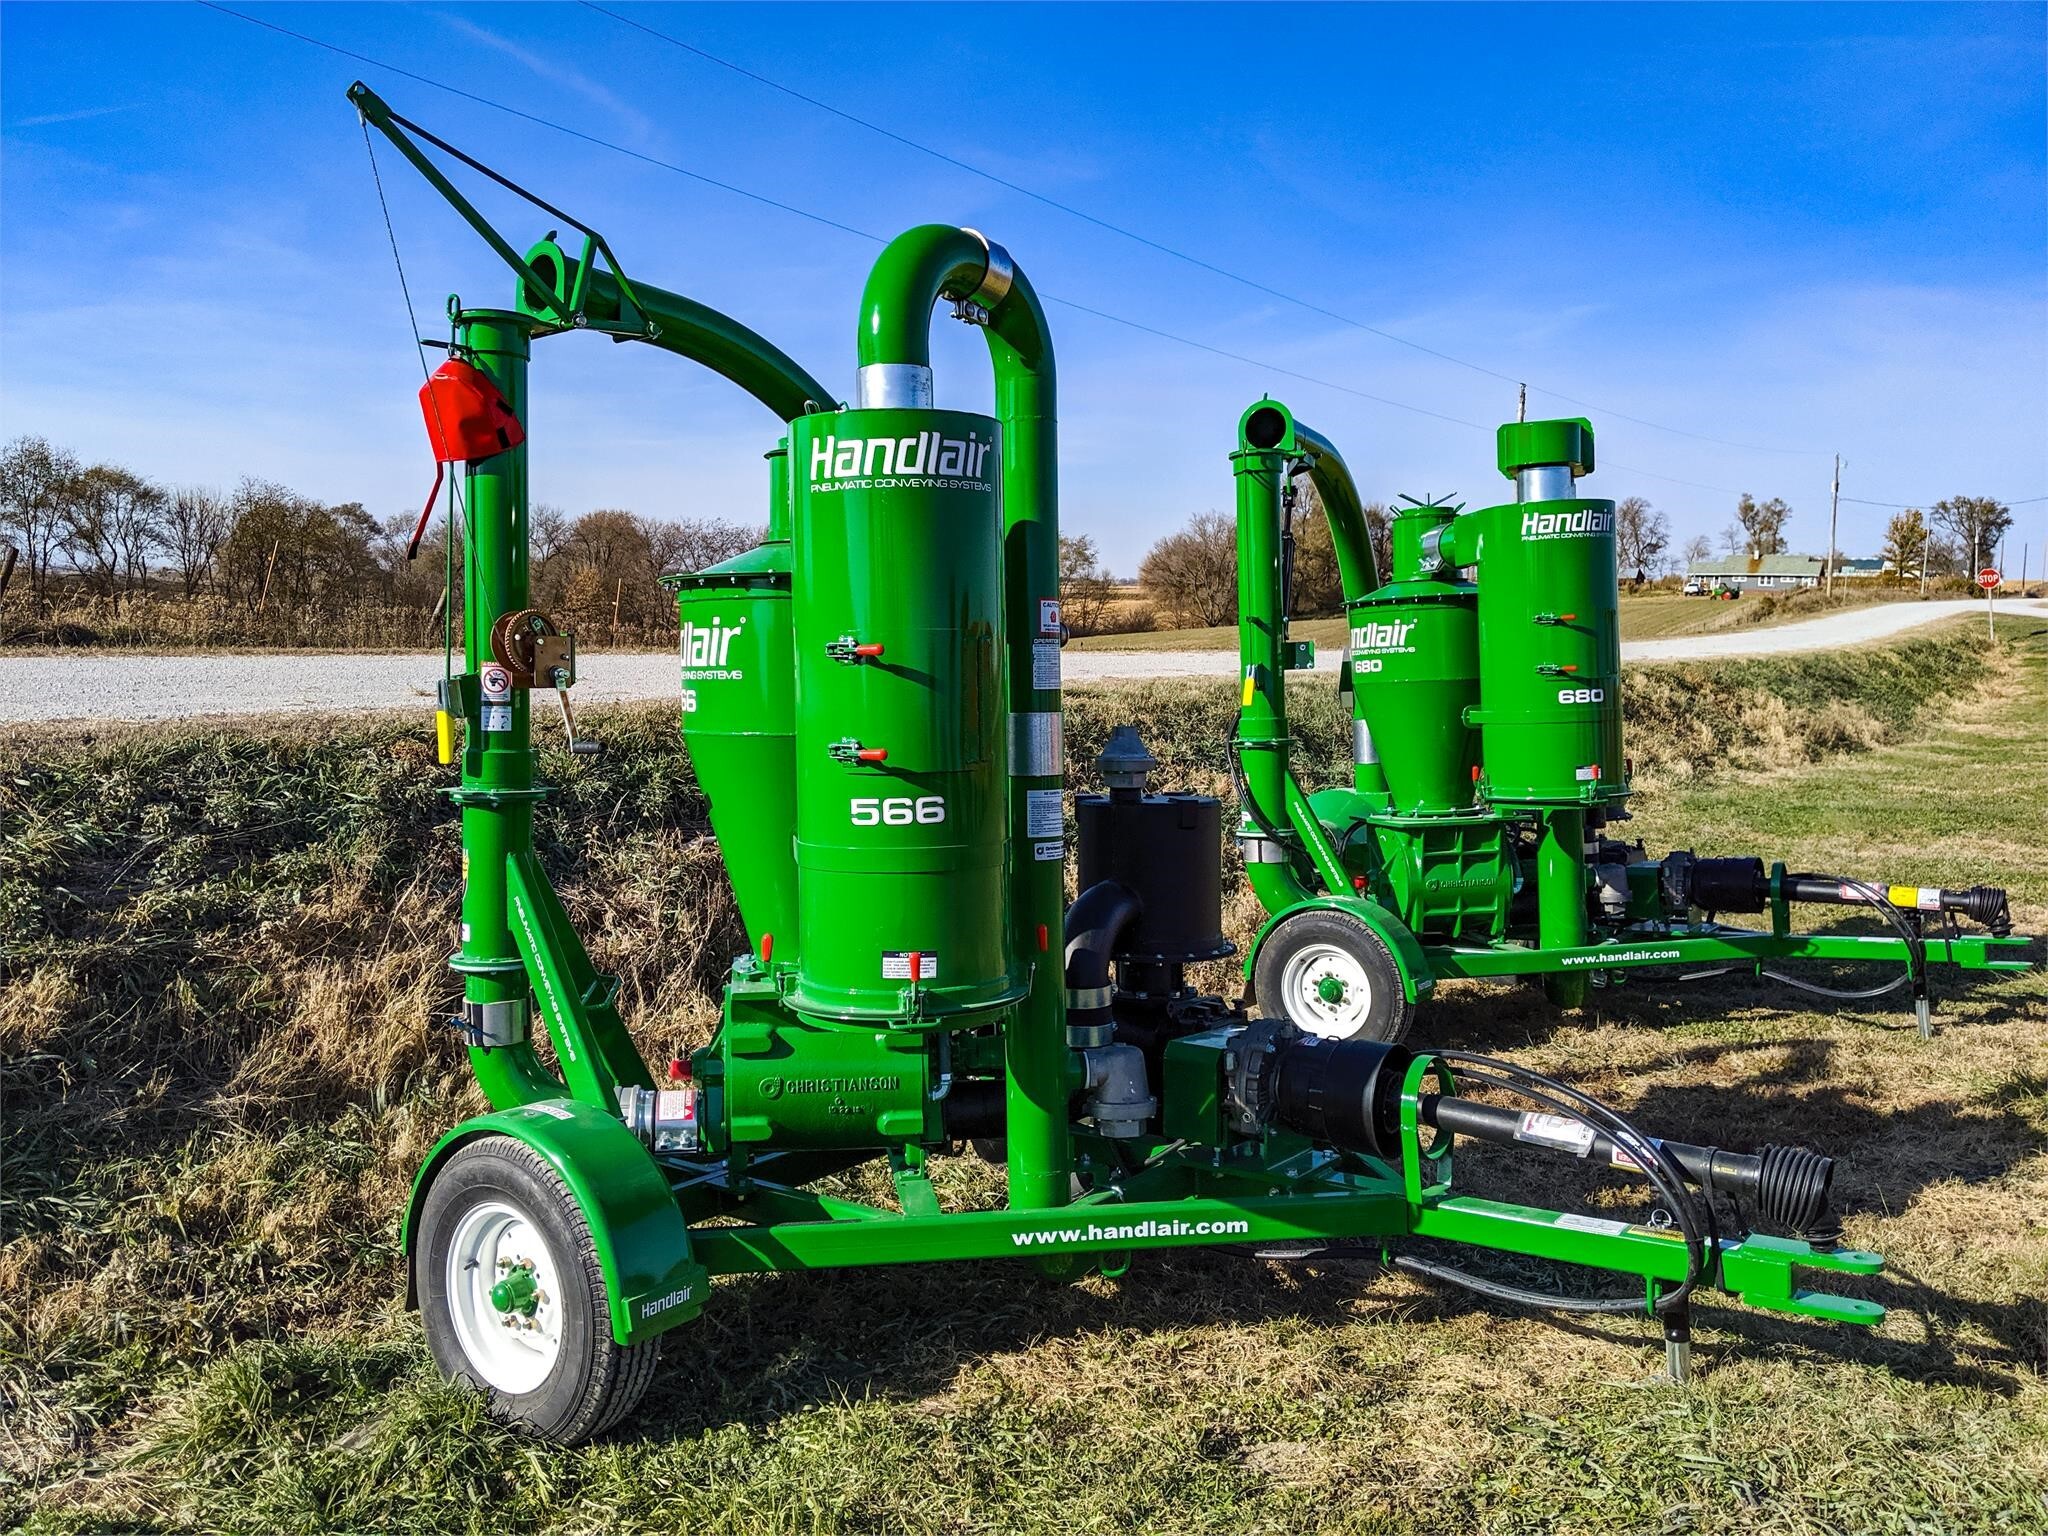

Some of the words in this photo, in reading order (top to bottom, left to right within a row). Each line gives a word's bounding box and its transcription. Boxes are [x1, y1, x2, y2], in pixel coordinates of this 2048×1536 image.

[810, 431, 991, 481] Handlair
[811, 479, 873, 494] PNEUMATIC
[874, 478, 948, 489] CONVEYING
[949, 480, 992, 492] SYSTEMS
[1520, 508, 1613, 535] Handlair
[1979, 574, 1999, 584] STOP
[1355, 659, 1383, 673] 680
[697, 669, 743, 680] SYSTEMS
[1558, 688, 1604, 704] 680
[850, 796, 946, 826] 566
[1561, 950, 1680, 966] www.handlair.com
[1011, 1219, 1249, 1246] www.handlair.com
[641, 1285, 693, 1319] Handlair
